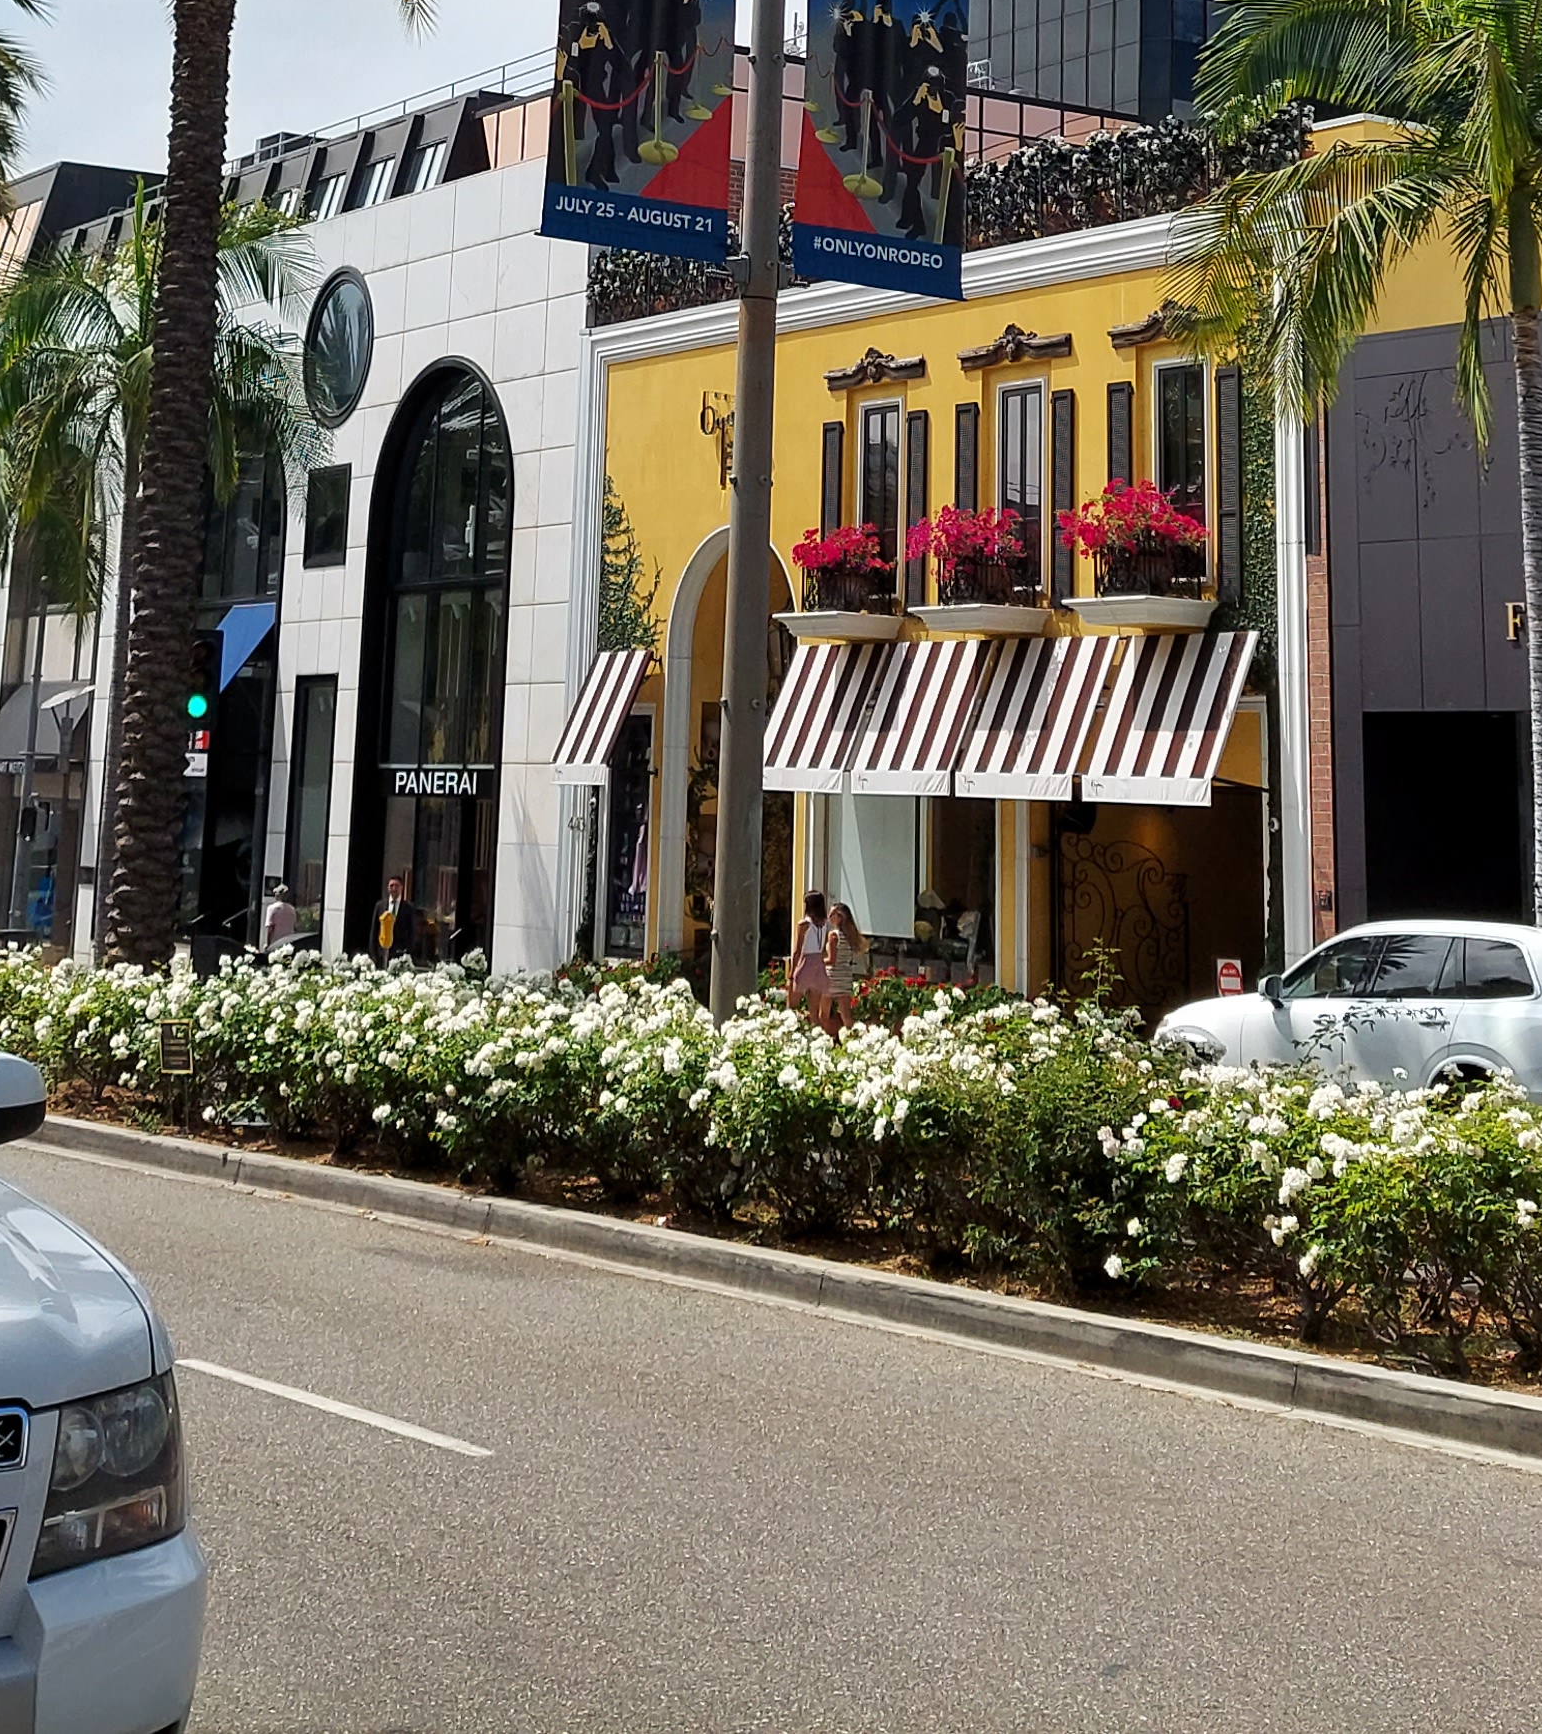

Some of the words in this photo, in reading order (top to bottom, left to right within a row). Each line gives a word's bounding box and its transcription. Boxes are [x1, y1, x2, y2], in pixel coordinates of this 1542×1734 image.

[555, 195, 594, 215] JULY
[595, 201, 616, 218] 25
[627, 206, 692, 230] AUGUST
[694, 217, 713, 233] 21
[813, 235, 944, 270] #ONLYONRODEO
[394, 770, 478, 796] PANERAI
